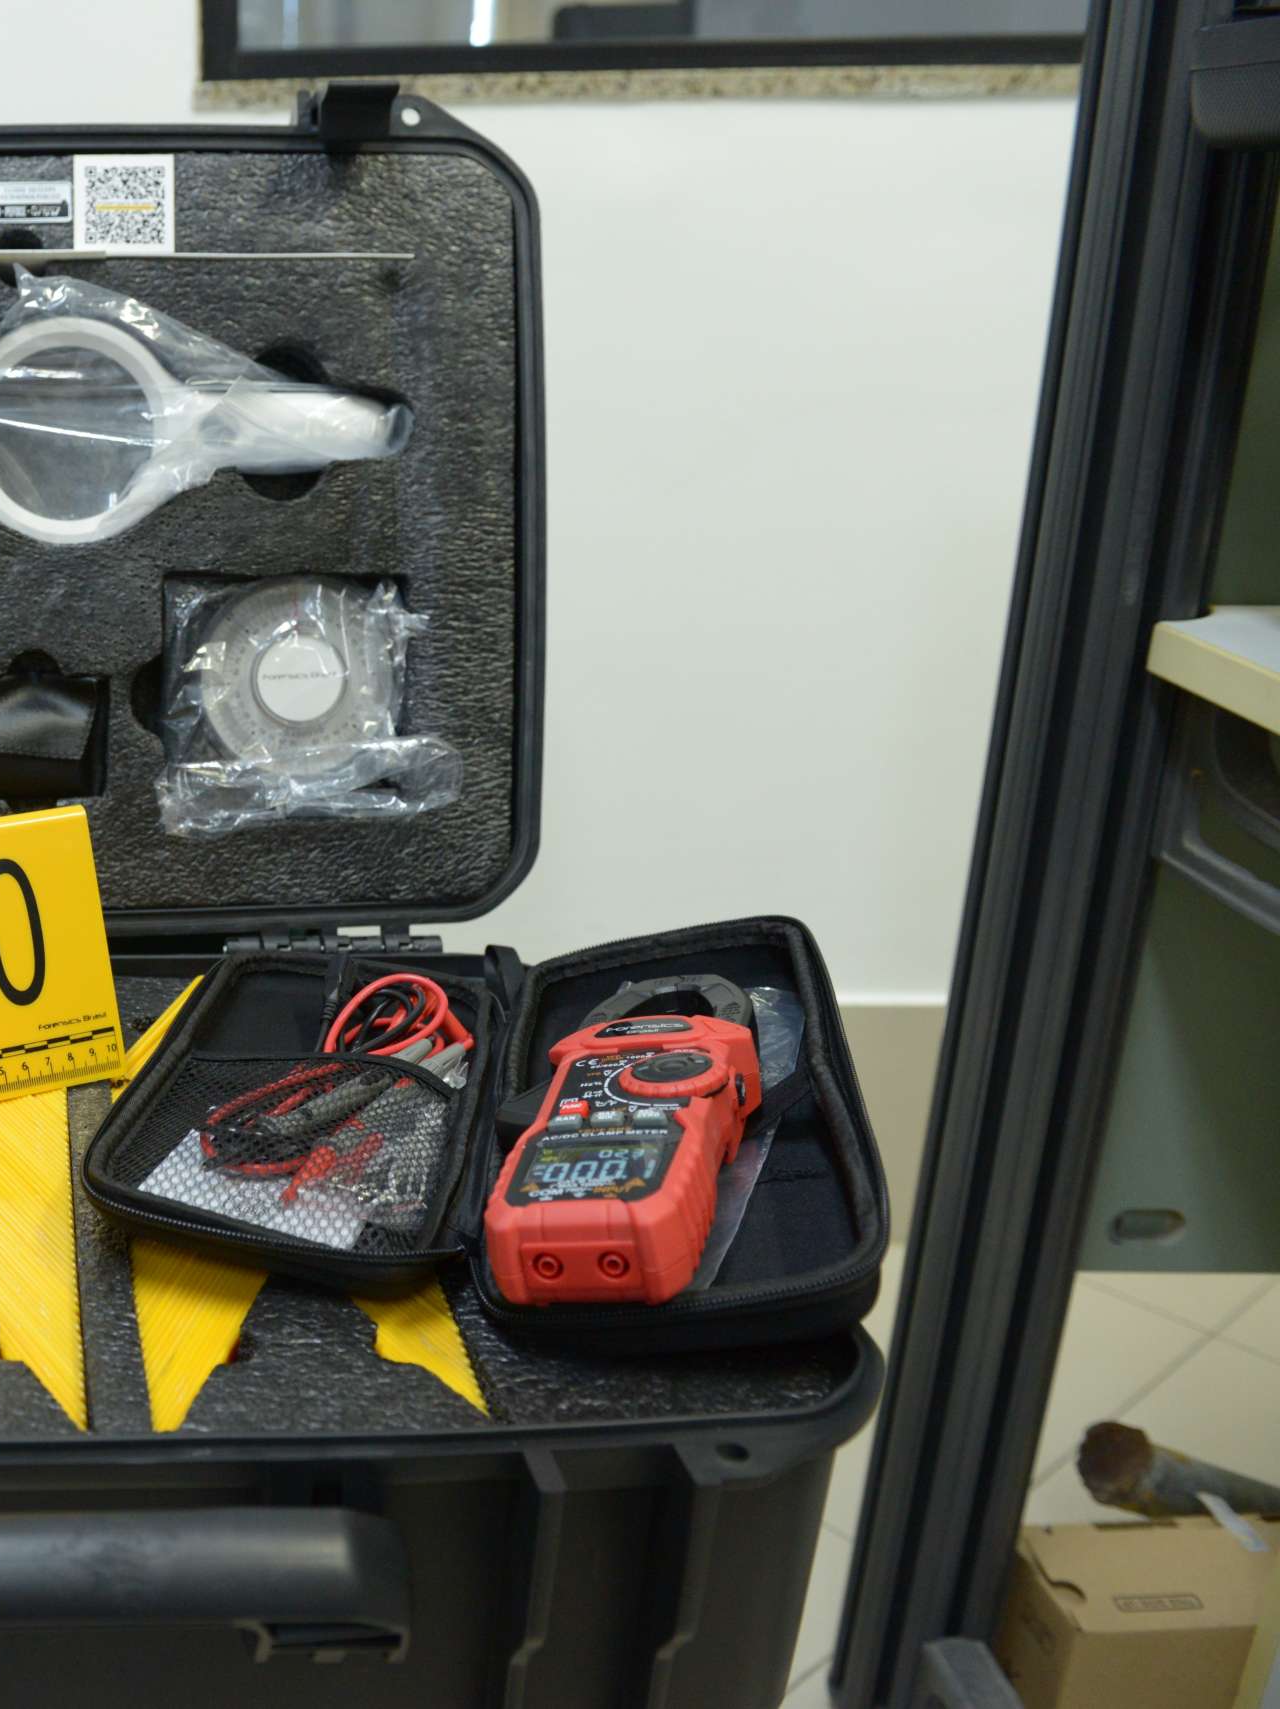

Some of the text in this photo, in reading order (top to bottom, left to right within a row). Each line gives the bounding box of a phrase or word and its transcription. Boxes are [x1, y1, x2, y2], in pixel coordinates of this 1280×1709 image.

[38, 1011, 107, 1031] Forensics Brasil
[541, 1128, 669, 1141] AC/DC CLAMP METER
[528, 1188, 565, 1198] COM
